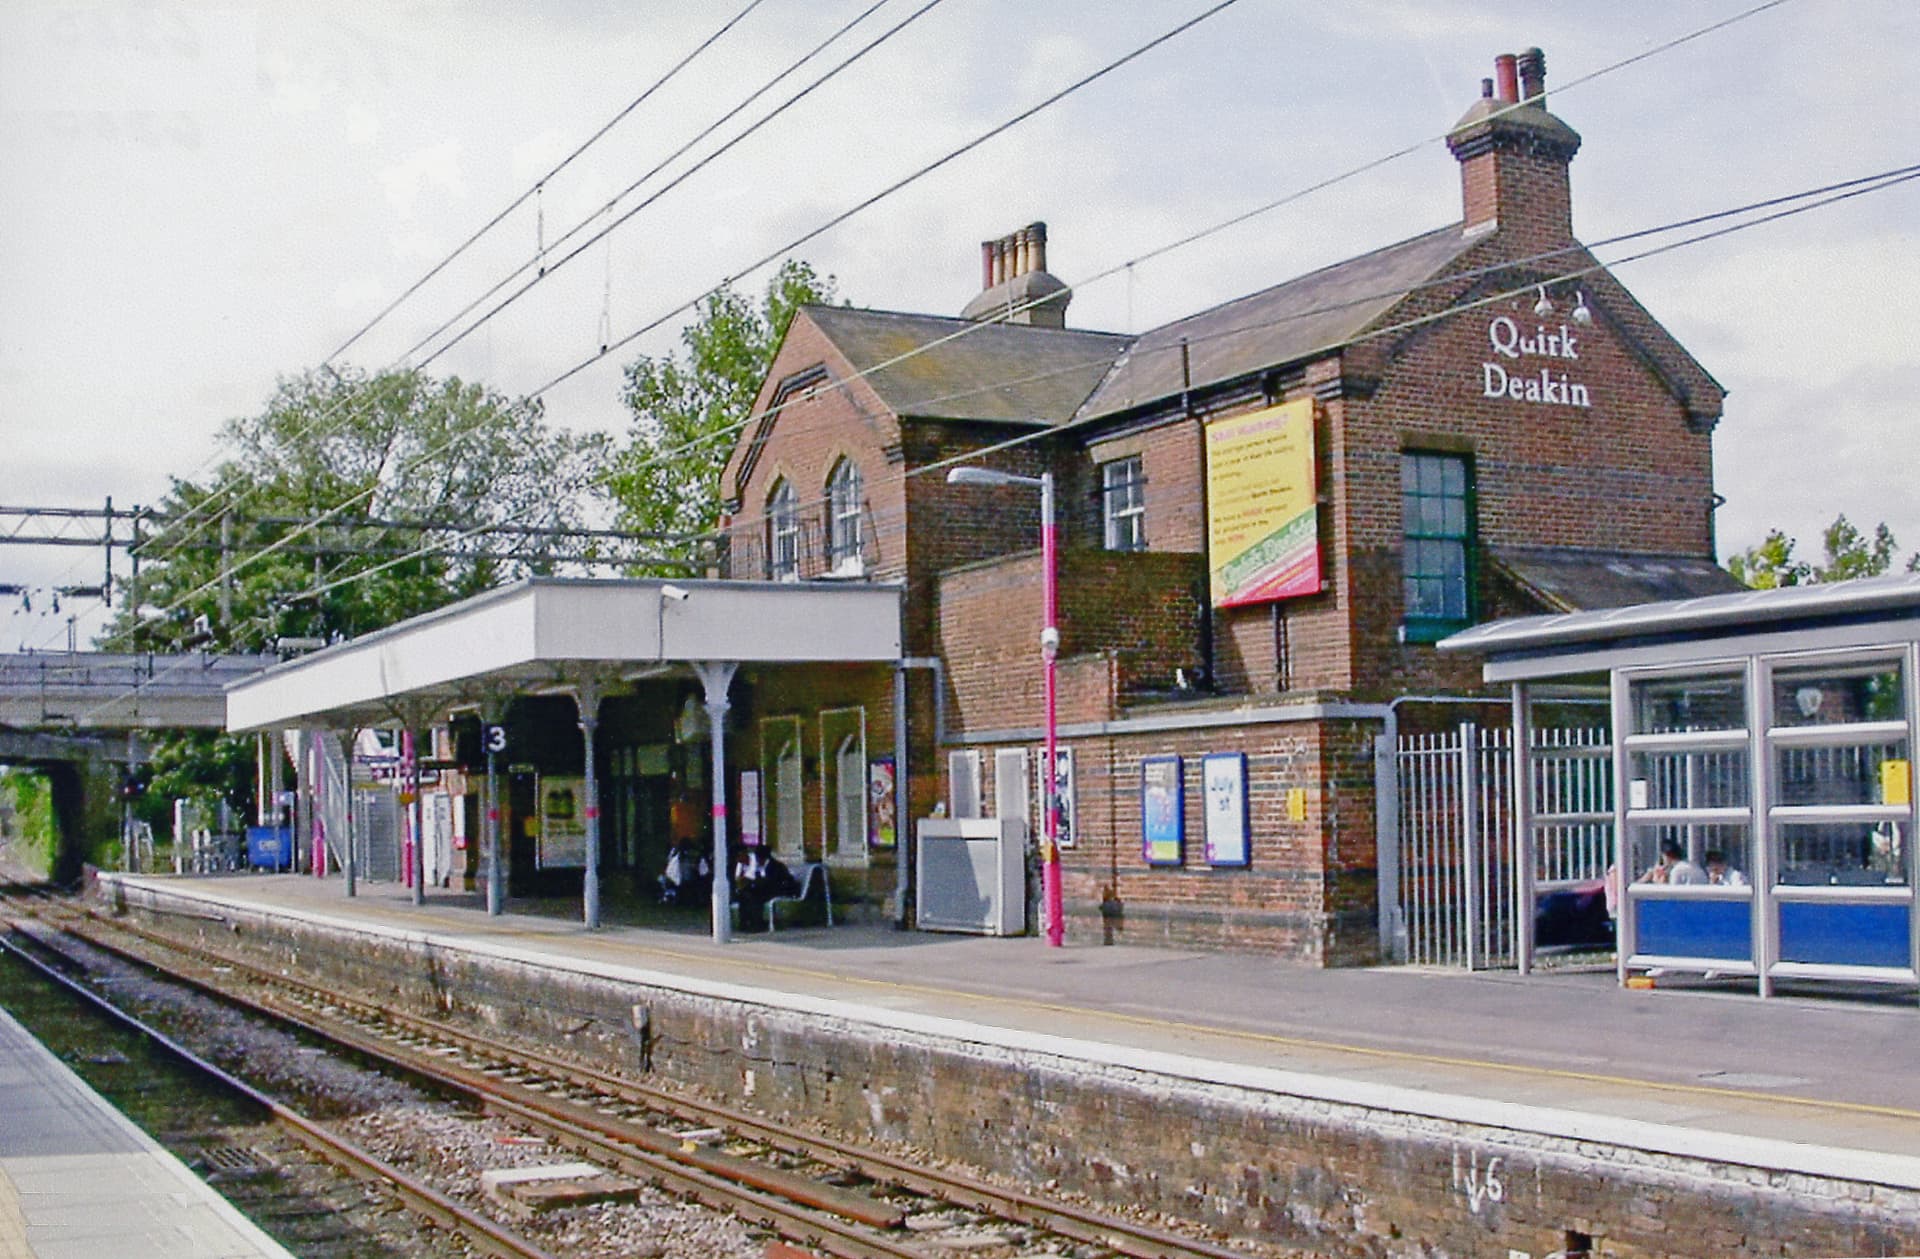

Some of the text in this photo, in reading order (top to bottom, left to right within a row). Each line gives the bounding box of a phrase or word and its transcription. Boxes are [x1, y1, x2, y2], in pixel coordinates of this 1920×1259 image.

[1489, 316, 1579, 361] Quirk
[1482, 362, 1591, 408] Deakin
[488, 726, 507, 753] 3
